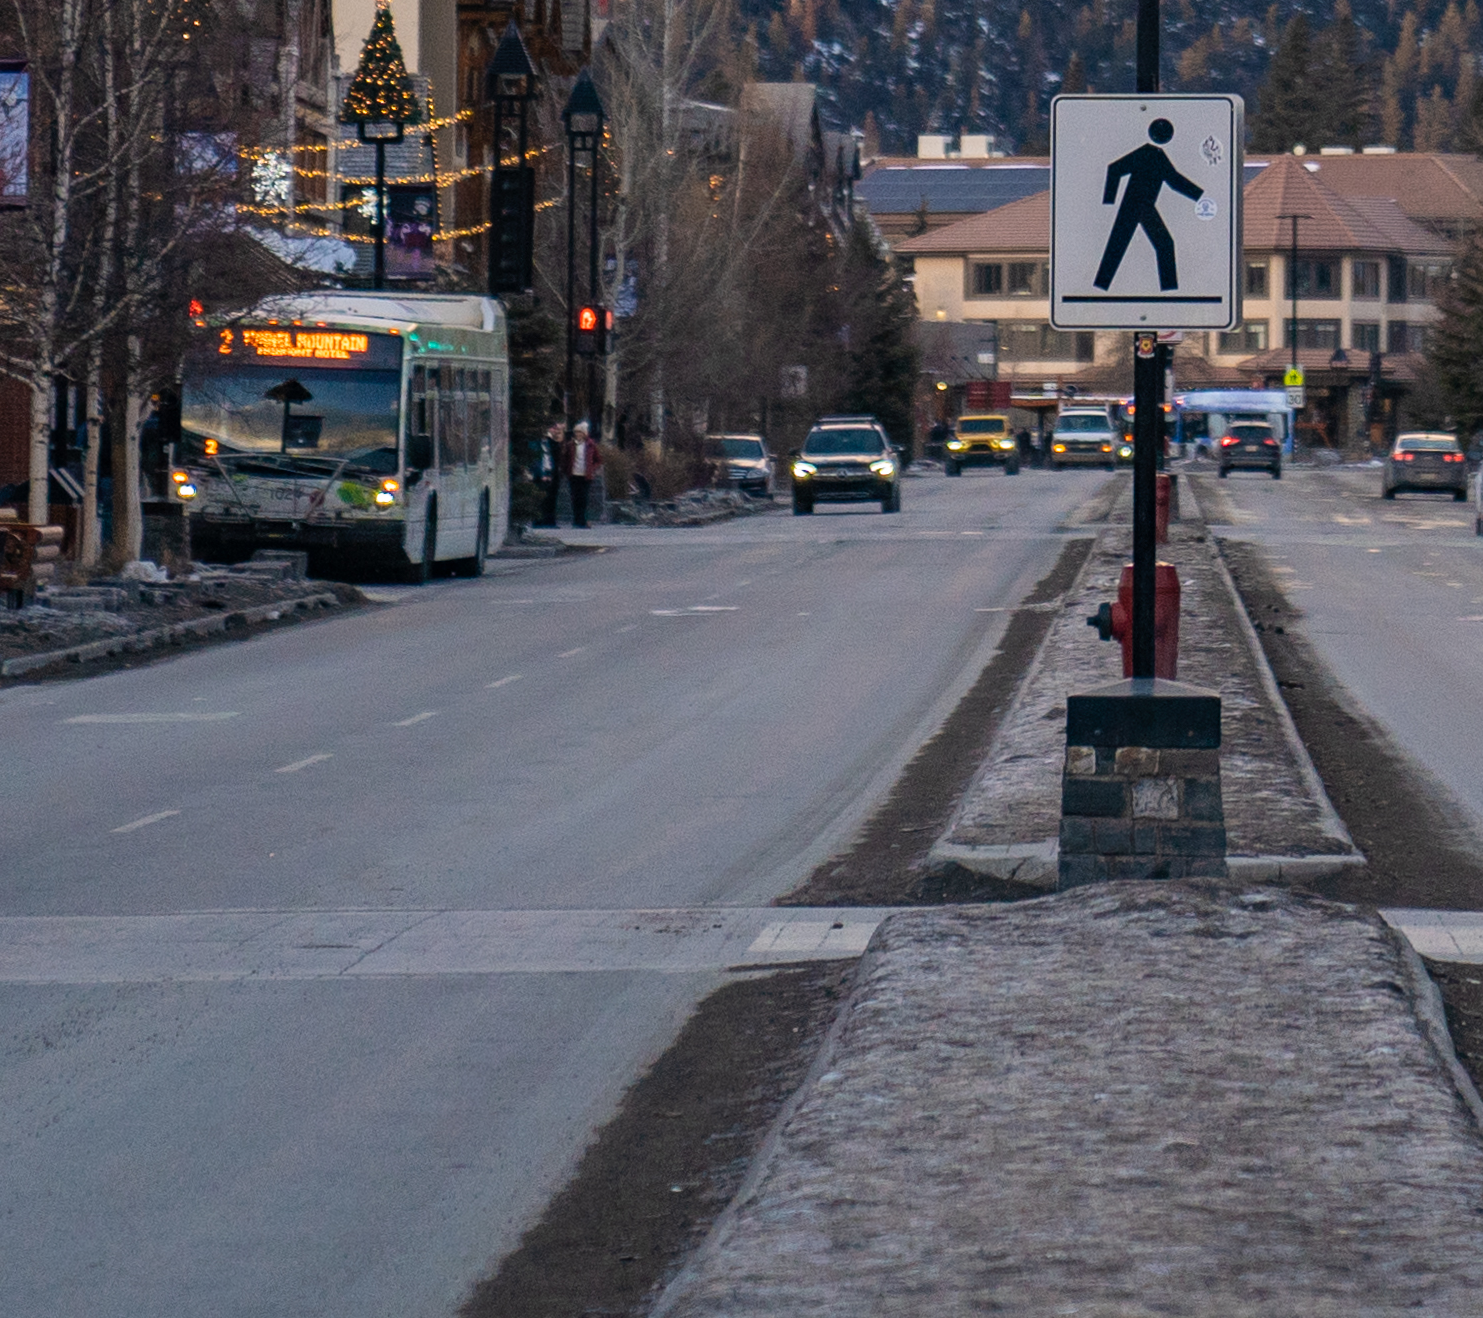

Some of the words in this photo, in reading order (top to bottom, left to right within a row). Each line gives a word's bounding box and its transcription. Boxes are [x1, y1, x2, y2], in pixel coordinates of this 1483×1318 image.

[219, 329, 233, 354] 2
[296, 332, 368, 352] MOUNTAIN
[205, 439, 218, 455] 2
